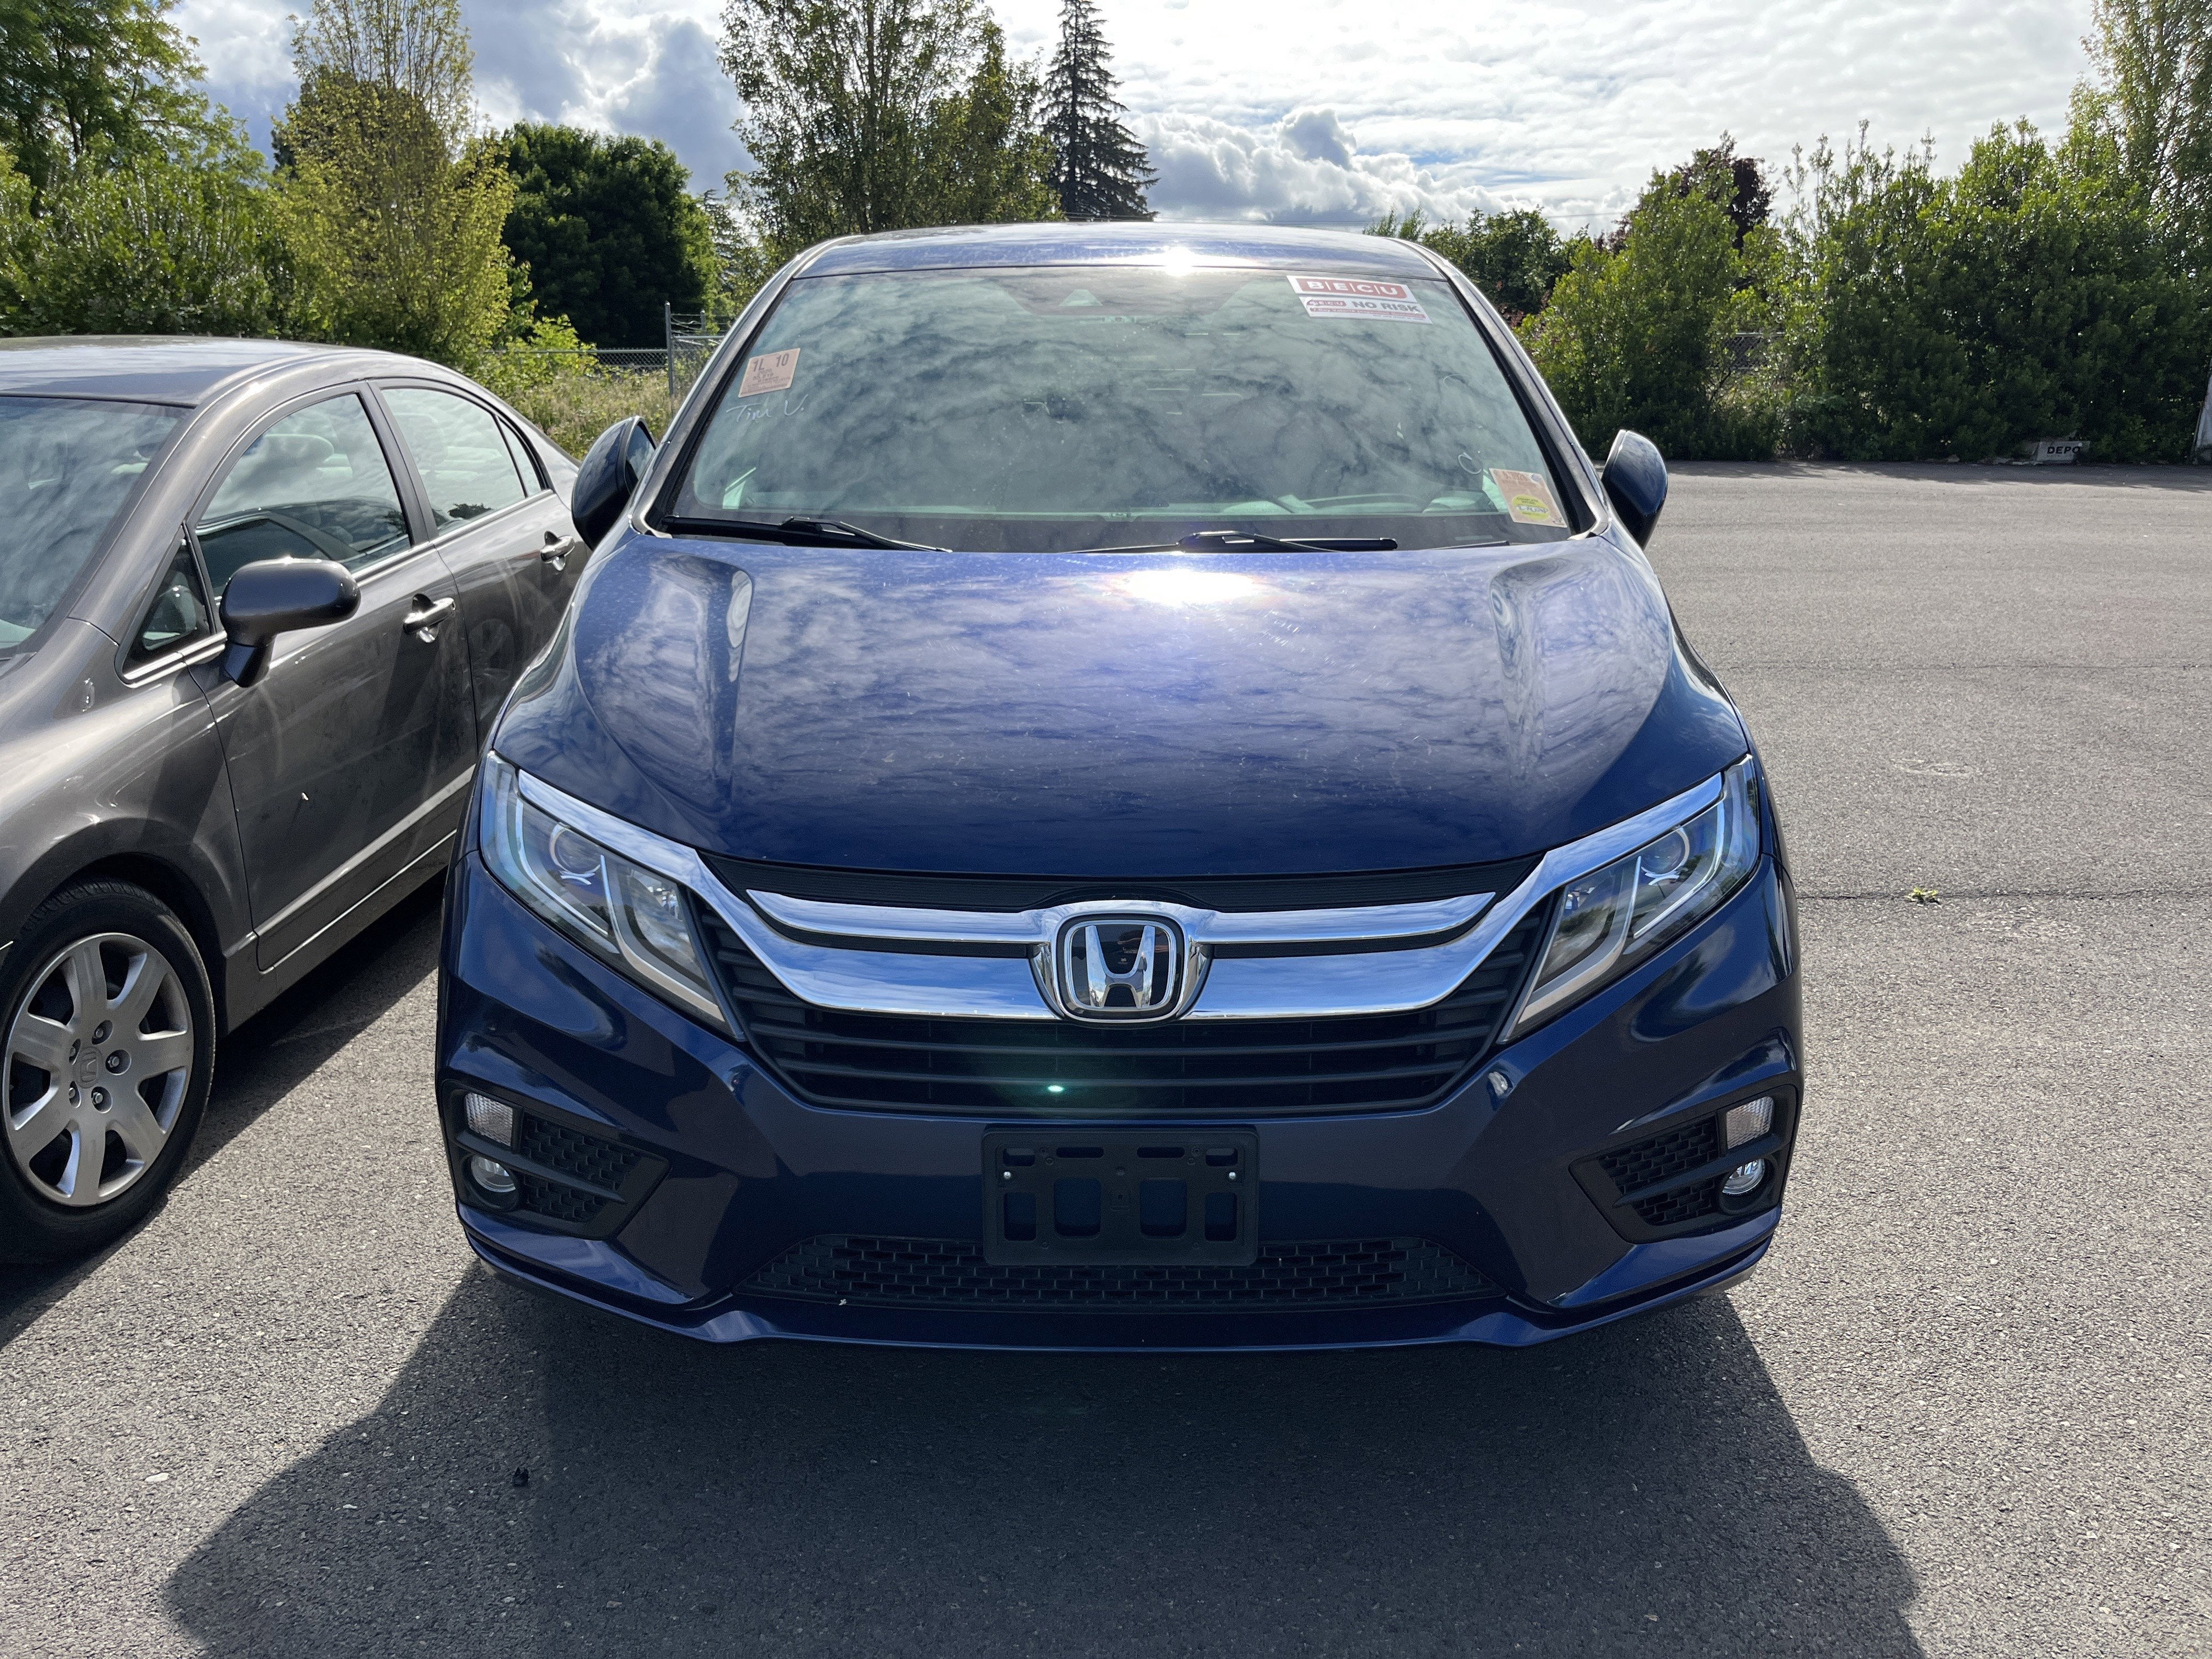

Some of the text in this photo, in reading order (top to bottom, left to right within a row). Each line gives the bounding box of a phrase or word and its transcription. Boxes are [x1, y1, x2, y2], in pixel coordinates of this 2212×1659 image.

[1351, 301, 1377, 309] NO
[1380, 302, 1421, 313] RISK
[776, 353, 790, 368] 10
[2047, 446, 2081, 454] DEPO
